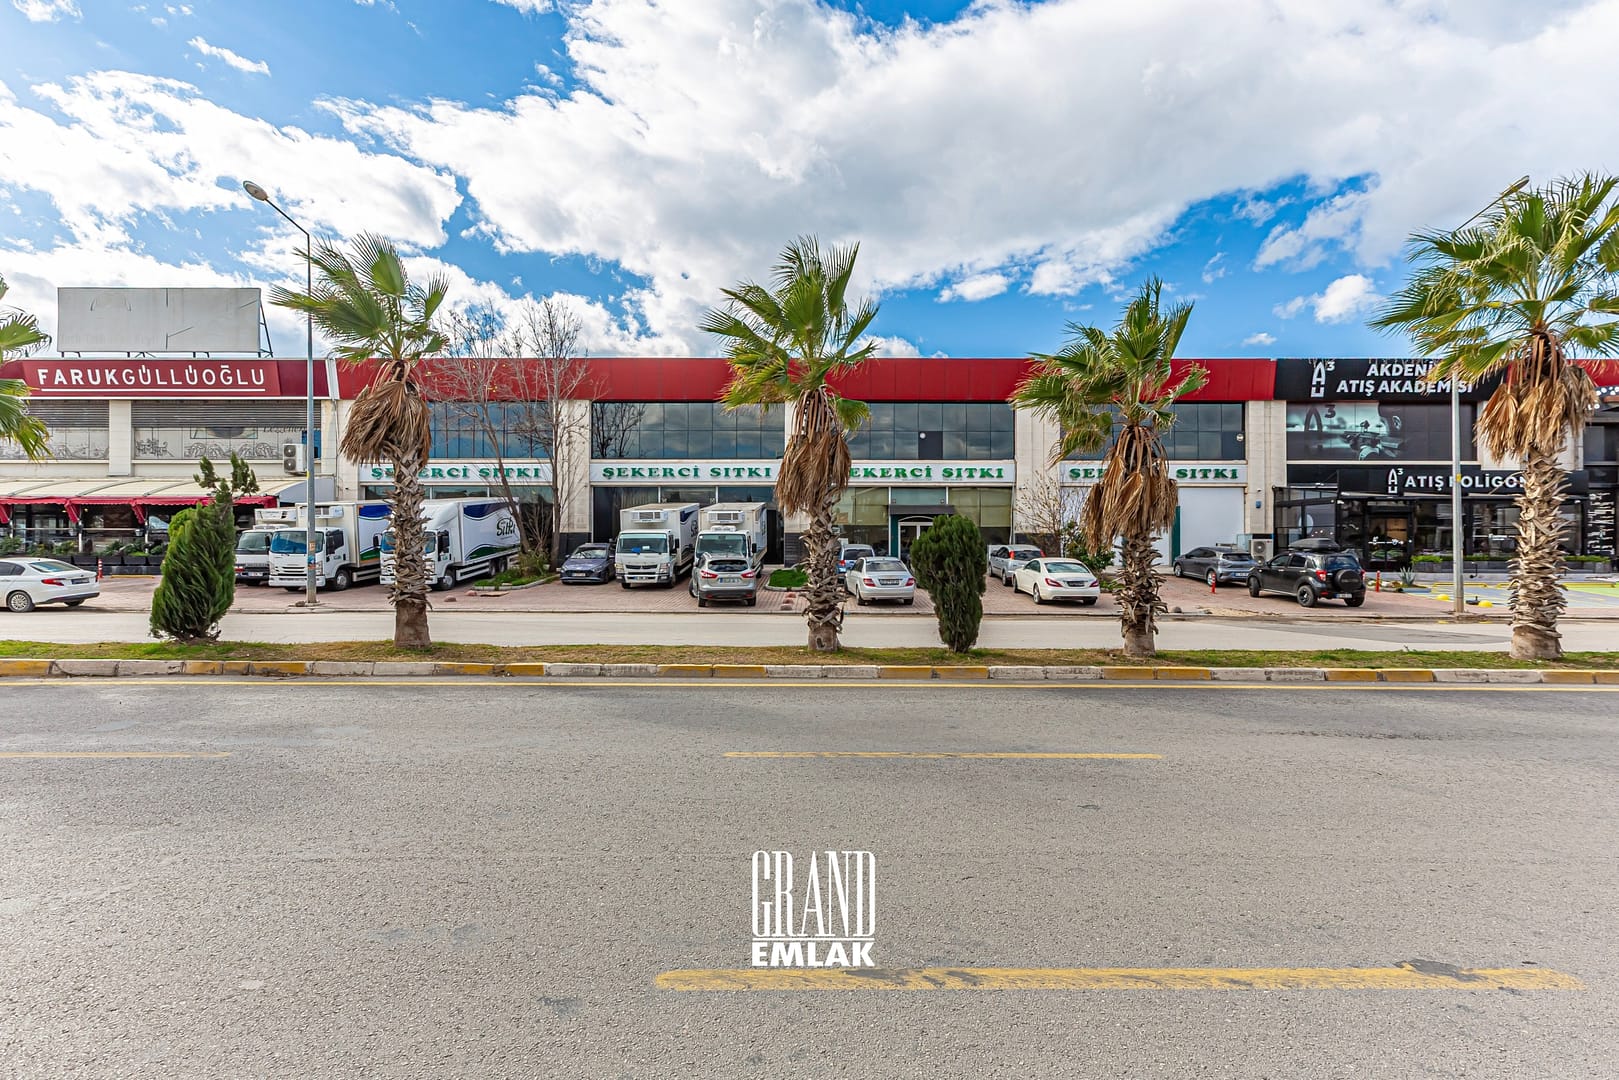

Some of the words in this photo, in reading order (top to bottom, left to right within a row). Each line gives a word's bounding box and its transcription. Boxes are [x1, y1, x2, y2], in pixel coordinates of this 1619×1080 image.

[37, 364, 265, 386] FARUKGÜLLÜOĞLU
[1366, 361, 1436, 377] AKDENİ
[1336, 380, 1375, 397] ATIŞ
[371, 466, 469, 480] ŞEERCİ
[602, 465, 700, 480] ŞEKERCİ
[709, 467, 772, 478] SITKI
[850, 465, 933, 479] EKERCİ
[942, 467, 1004, 478] SITKI
[1175, 468, 1239, 480] SITKI
[1404, 475, 1445, 491] ATIŞ
